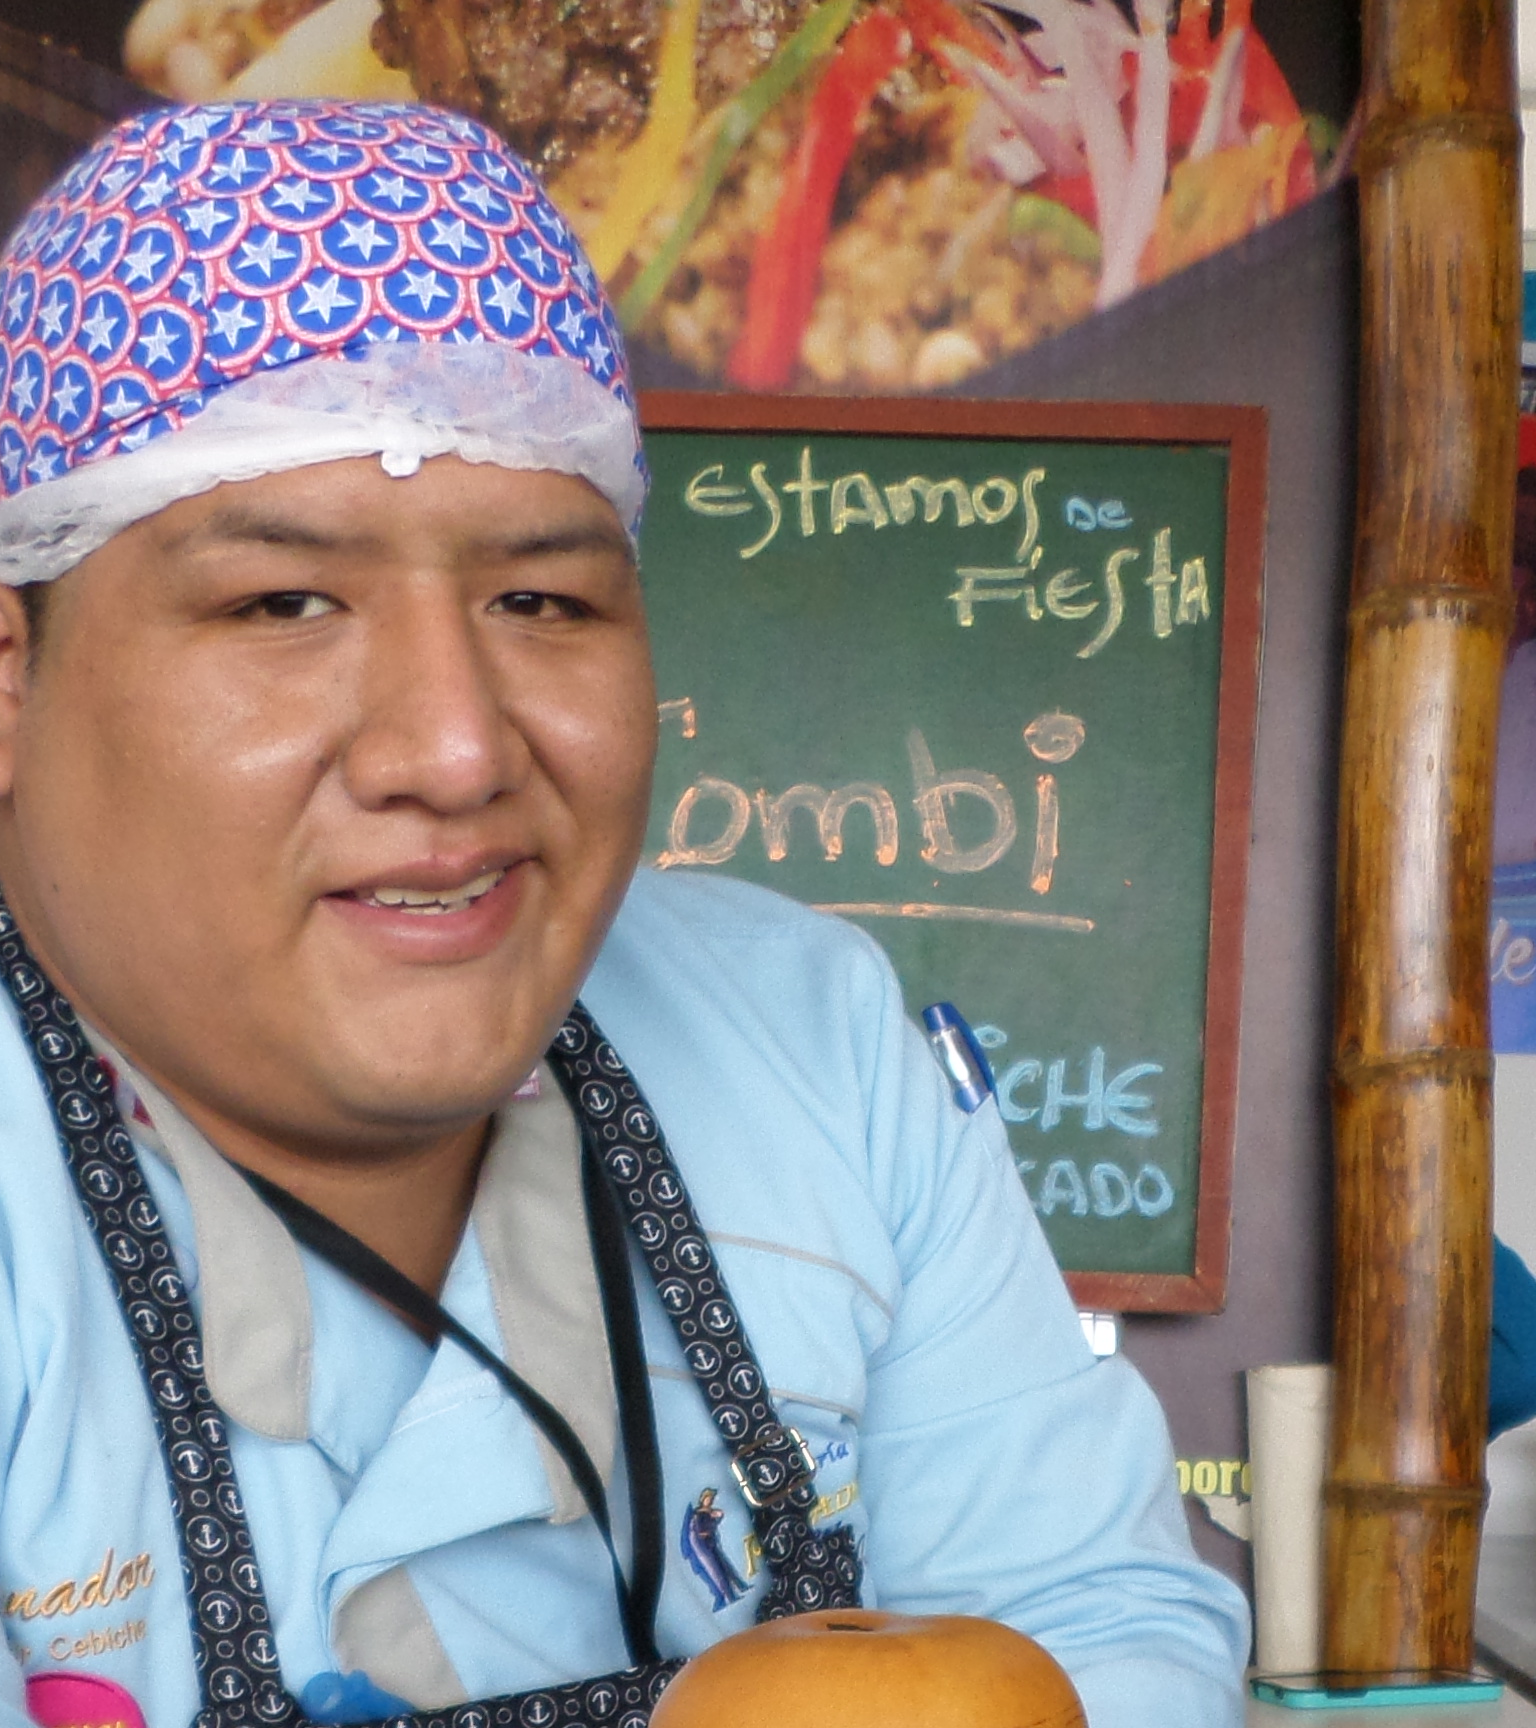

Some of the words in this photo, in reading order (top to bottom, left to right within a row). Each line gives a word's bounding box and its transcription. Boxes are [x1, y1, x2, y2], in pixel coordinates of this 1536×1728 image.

[1065, 495, 1132, 530] DE
[658, 697, 1086, 896] ombi
[973, 1026, 1162, 1136] CHE
[6, 1548, 155, 1619] nador
